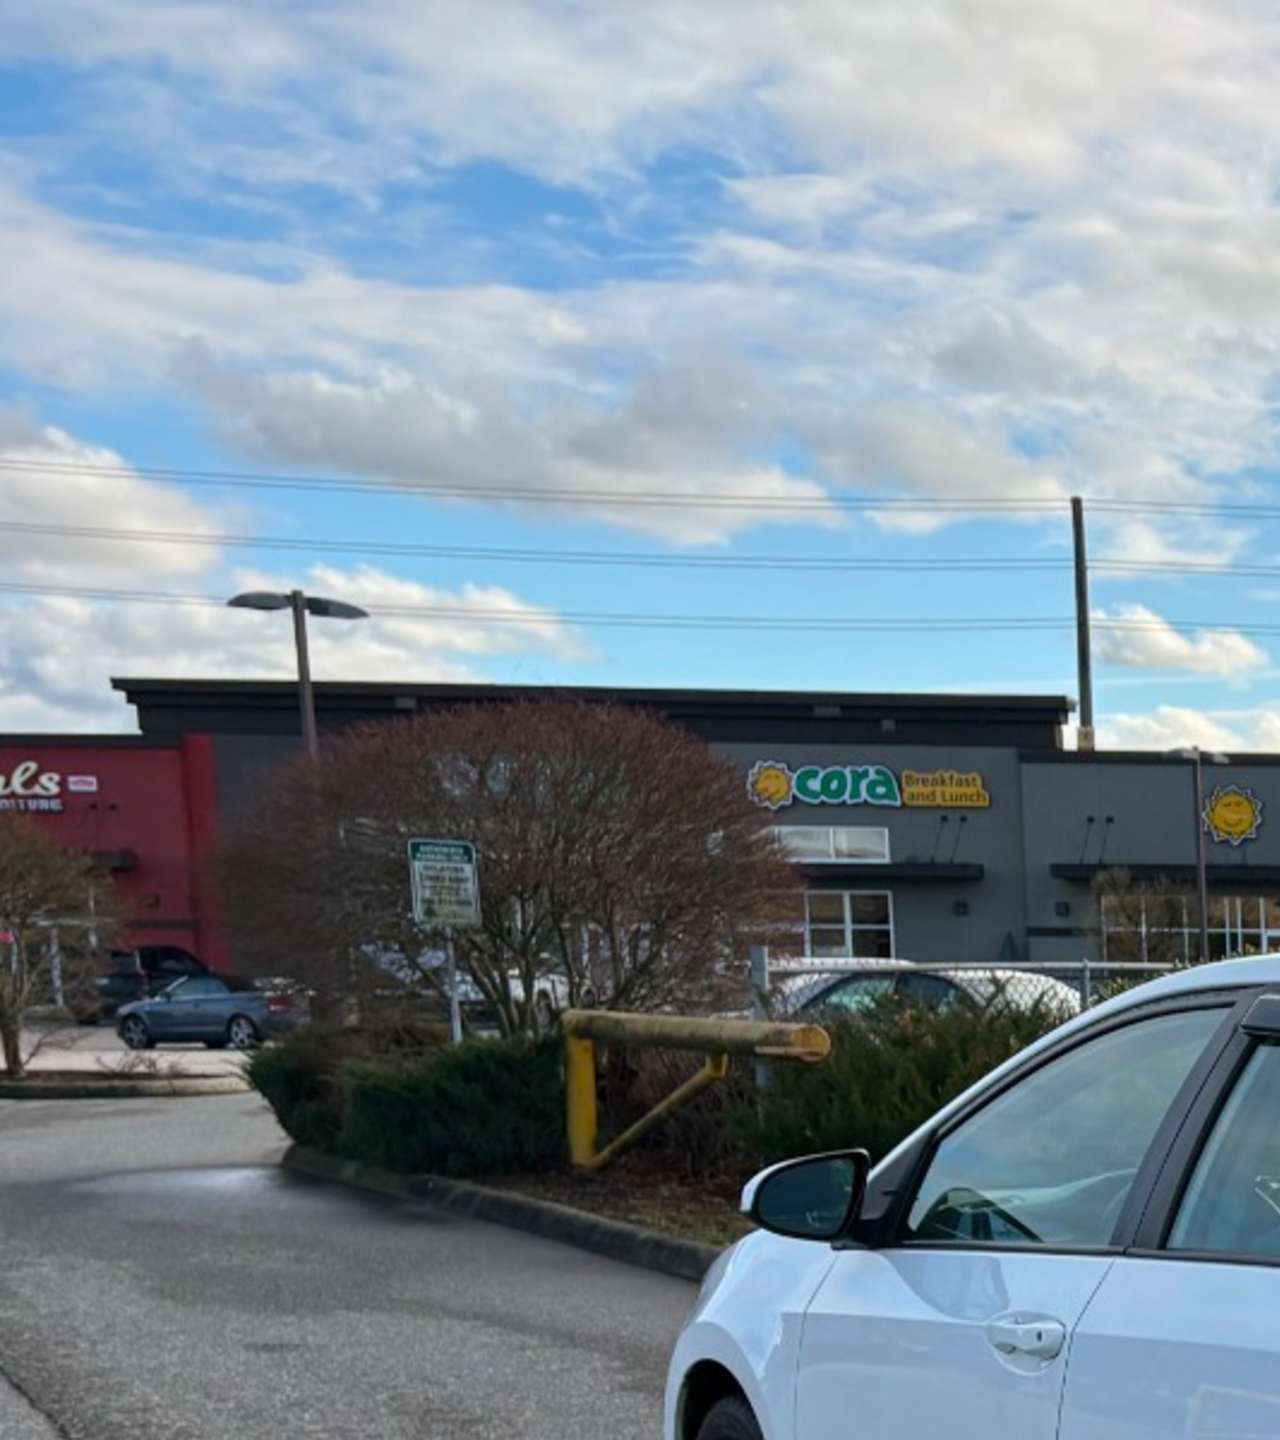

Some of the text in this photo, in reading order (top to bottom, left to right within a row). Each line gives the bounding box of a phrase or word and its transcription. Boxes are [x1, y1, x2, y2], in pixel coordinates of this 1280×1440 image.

[794, 766, 901, 805] cora
[904, 772, 978, 787] Breakfast
[907, 789, 986, 803] and Lunch
